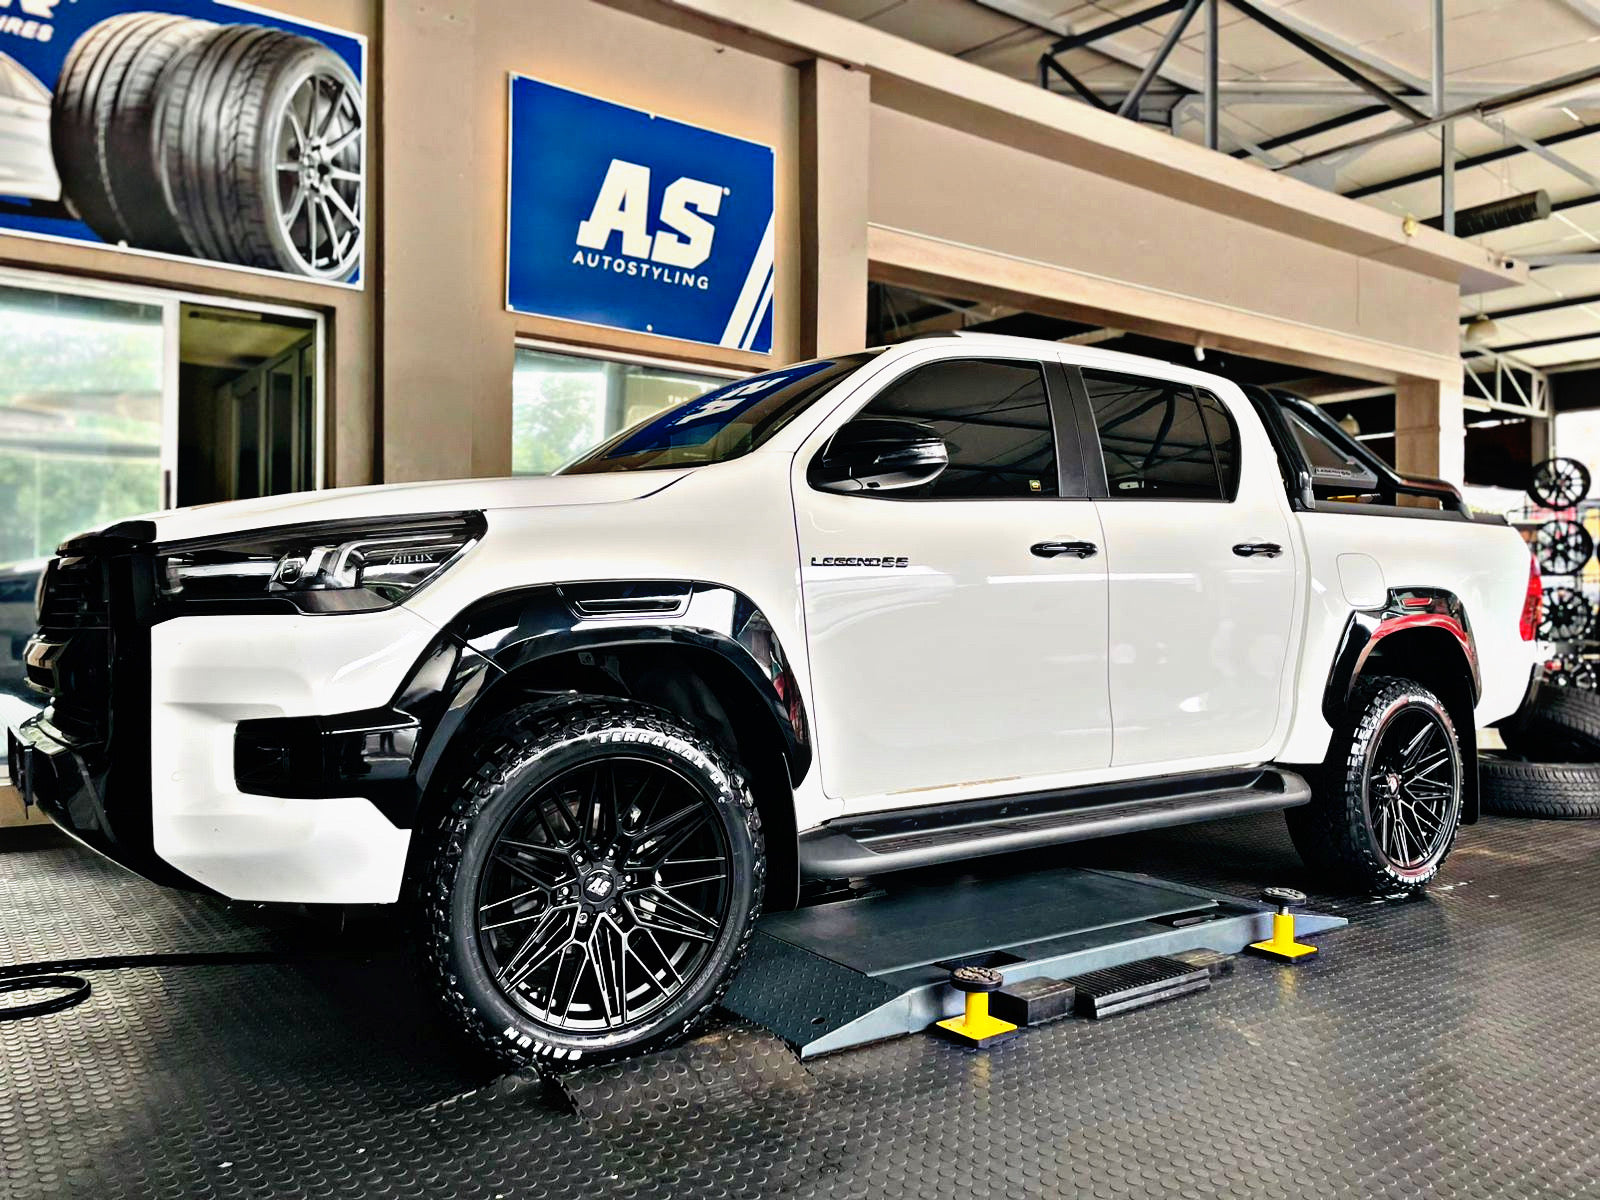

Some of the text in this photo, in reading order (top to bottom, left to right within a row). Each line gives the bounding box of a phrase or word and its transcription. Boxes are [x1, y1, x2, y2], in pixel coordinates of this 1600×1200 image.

[576, 158, 724, 270] AS
[572, 250, 709, 290] AUTOSTYLING
[393, 553, 434, 564] HILUX
